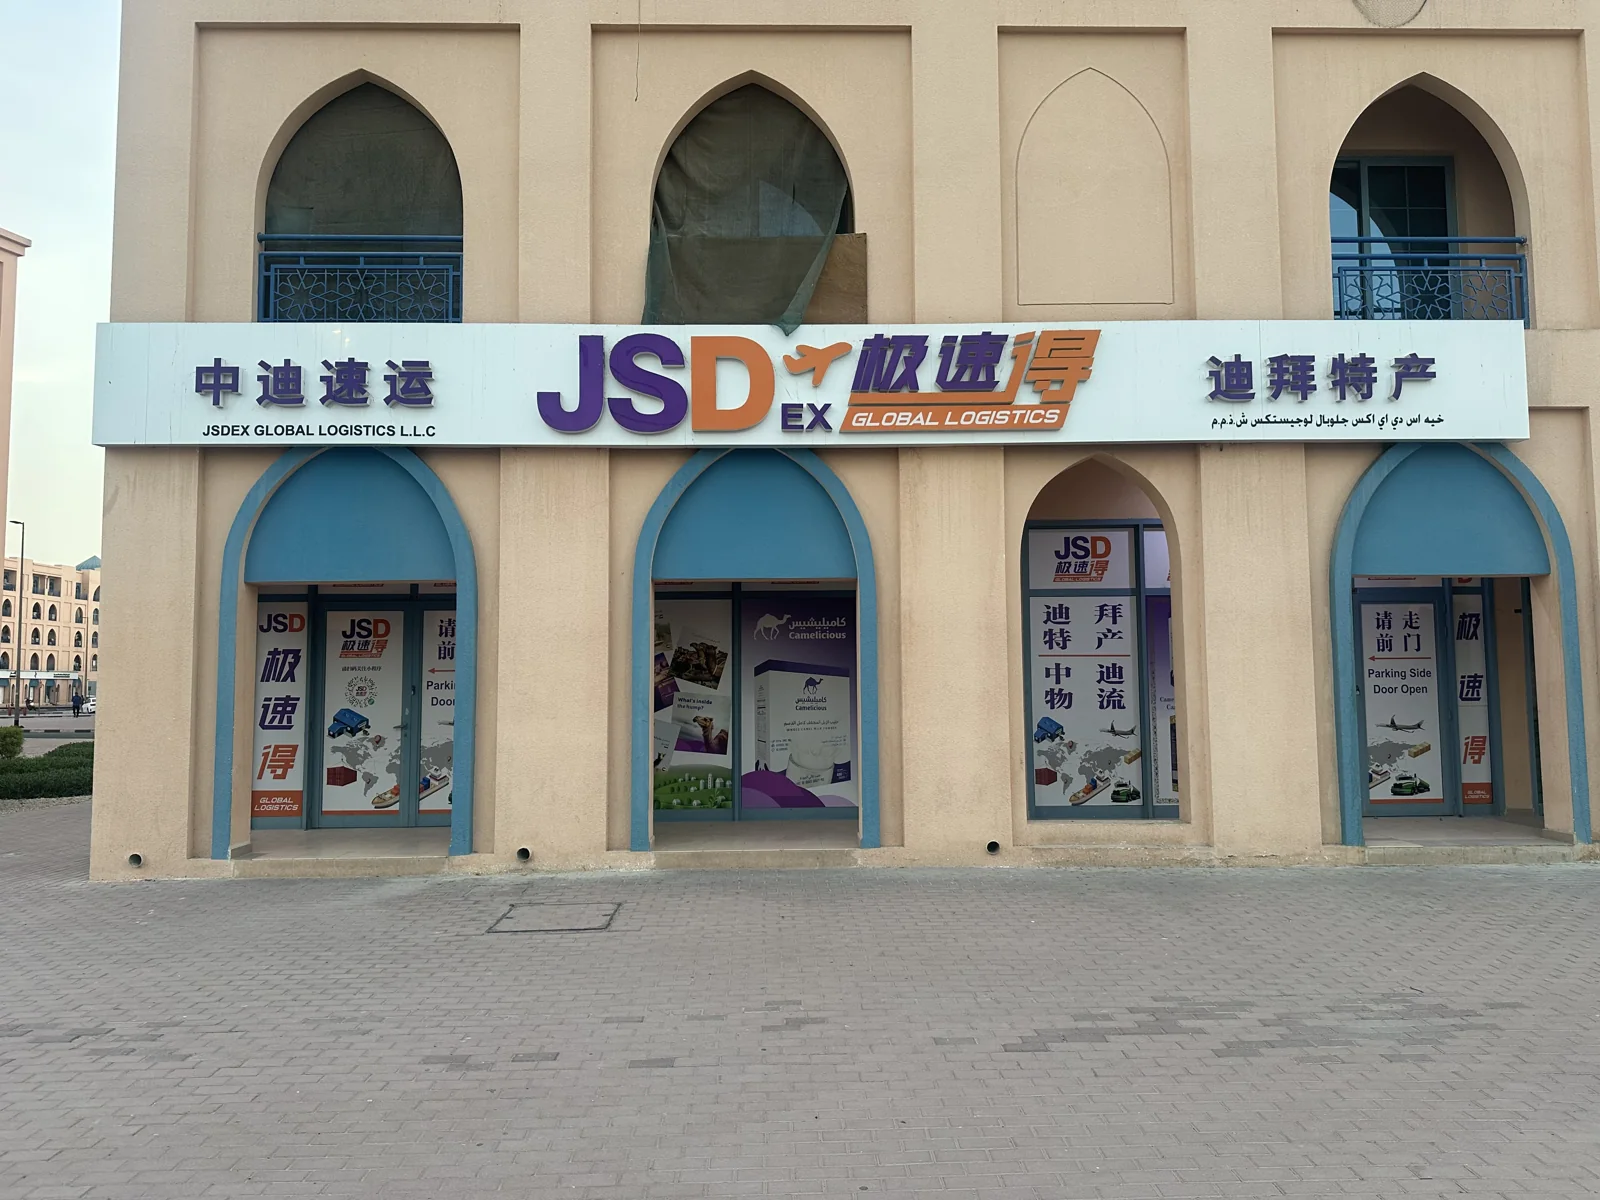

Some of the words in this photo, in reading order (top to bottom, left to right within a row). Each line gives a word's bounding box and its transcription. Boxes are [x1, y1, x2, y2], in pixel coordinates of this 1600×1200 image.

[849, 329, 1102, 404] 极速得
[194, 357, 434, 409] 中迪速运
[537, 333, 776, 434] JSD
[781, 403, 834, 433] EX
[1205, 352, 1437, 402] 迪拜特产
[851, 409, 940, 428] GLOBAL
[943, 407, 1061, 426] LOGISTICS
[1251, 413, 1313, 428] لوجيستكس
[1316, 413, 1349, 428] جلوبال
[1352, 412, 1375, 427] اكس
[1391, 415, 1404, 430] دي
[1406, 413, 1421, 427] اس
[202, 424, 250, 437] JSDEX
[253, 424, 315, 437] GLOBAL
[318, 424, 396, 437] LOGISTICS
[399, 425, 436, 438] L.L.C
[1054, 535, 1111, 560] JSD
[1054, 560, 1110, 576] 极速得
[259, 613, 306, 633] JSD
[341, 618, 391, 639] JSD
[437, 618, 456, 638] 请
[788, 616, 847, 630] كاميليشيس
[788, 630, 847, 640] Camelicious
[341, 639, 388, 655] 极速得
[437, 640, 456, 660] 前
[1368, 668, 1407, 680] Parking
[1409, 668, 1432, 679] Side
[426, 680, 456, 690] Parki
[1373, 684, 1398, 694] Door
[1401, 684, 1428, 696] Open
